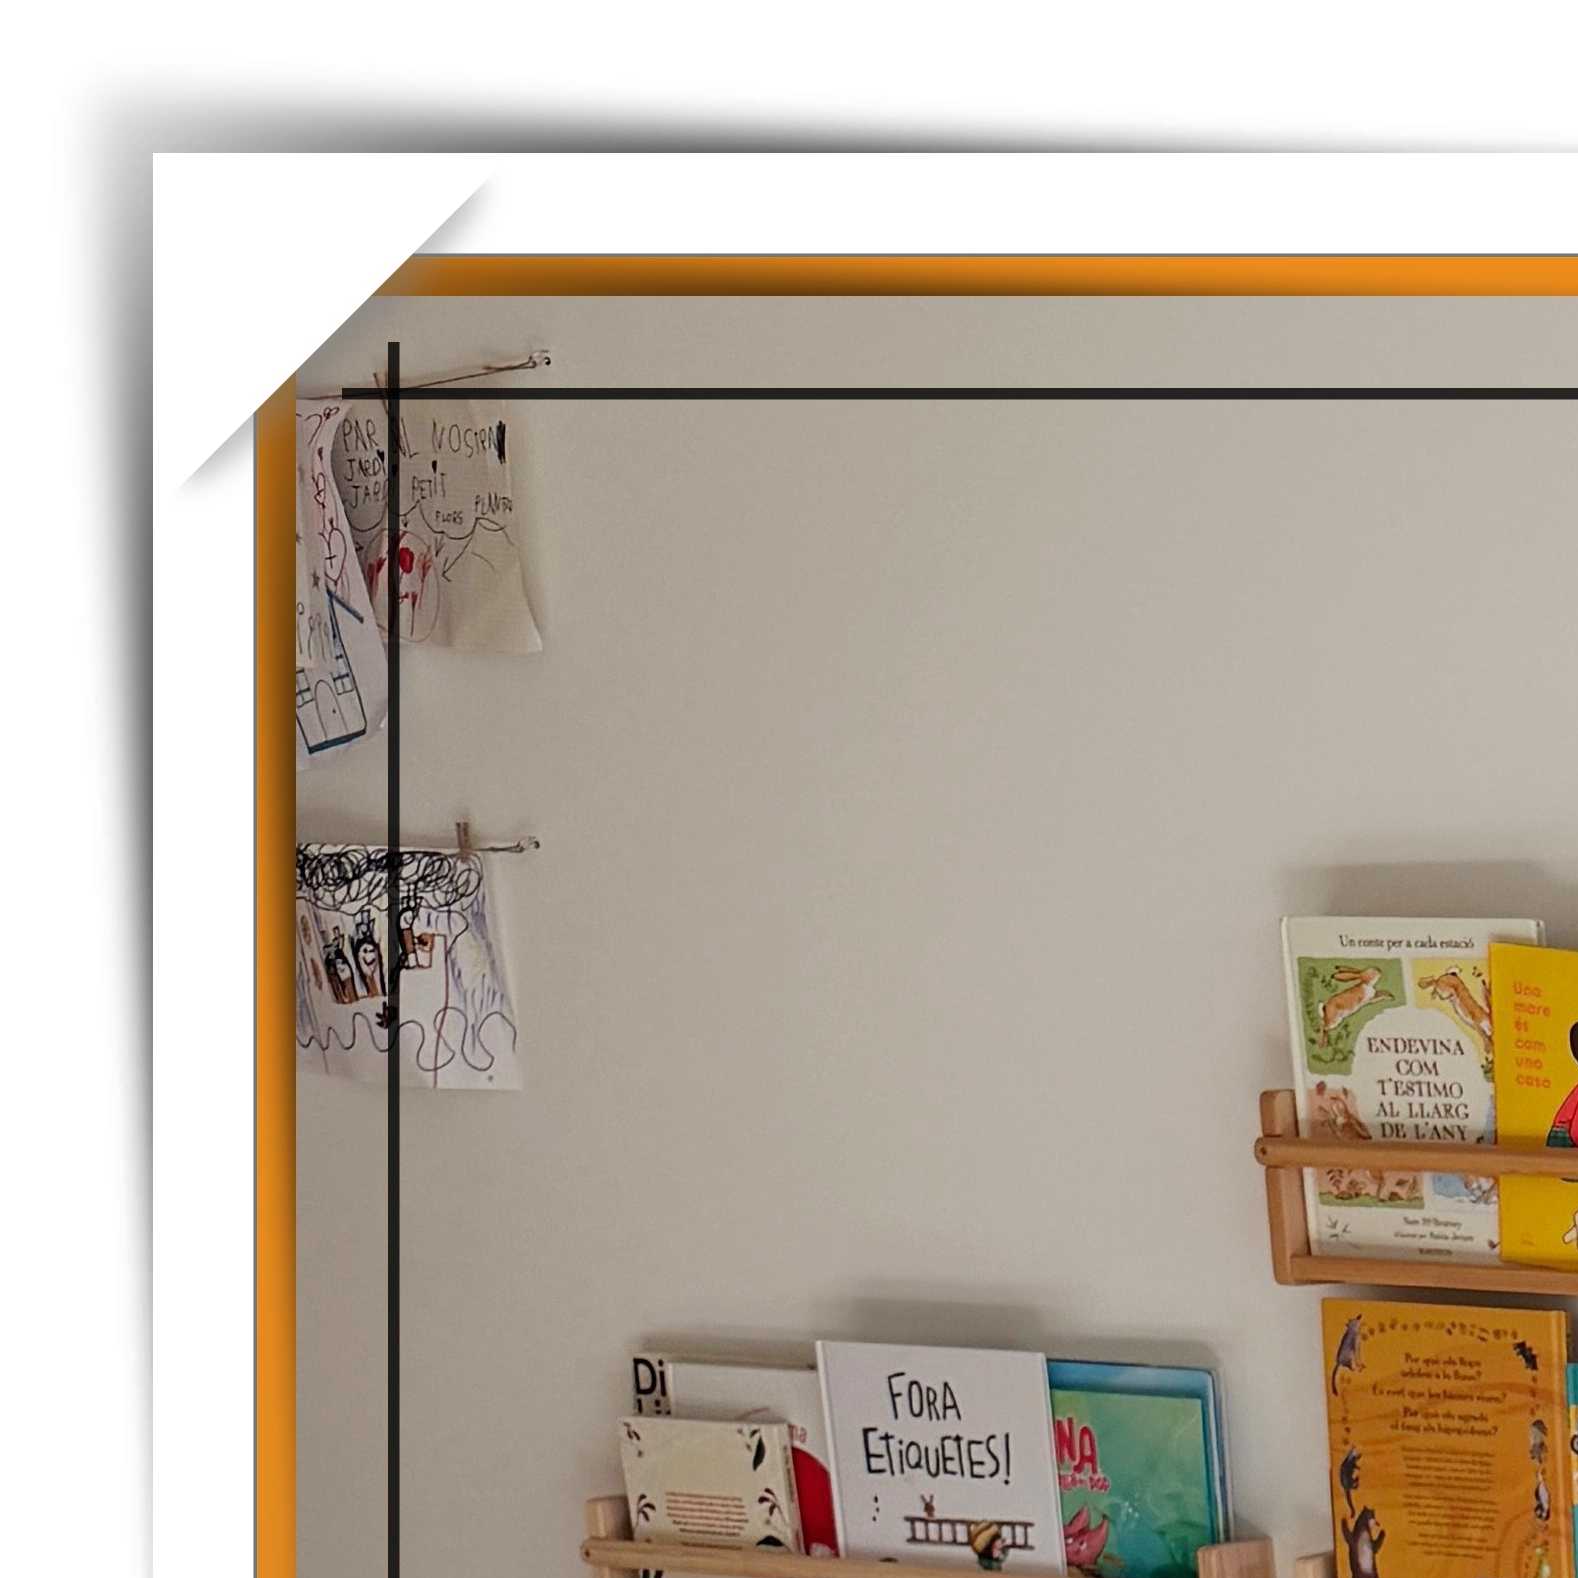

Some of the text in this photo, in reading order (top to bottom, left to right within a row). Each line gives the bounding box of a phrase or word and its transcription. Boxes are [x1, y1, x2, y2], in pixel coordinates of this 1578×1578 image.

[1339, 935, 1355, 949] Un
[1388, 939, 1404, 951] per
[1406, 940, 1412, 949] a
[1414, 936, 1438, 949] cada
[1513, 980, 1542, 998] Una
[1514, 1002, 1551, 1017] mare
[1367, 1037, 1465, 1056] ENDEVINA
[1514, 1038, 1546, 1052] com
[1396, 1059, 1439, 1077] COM
[1515, 1056, 1543, 1069] una
[1377, 1078, 1464, 1099] T'ESTIMO
[1515, 1073, 1551, 1089] casa
[1376, 1102, 1470, 1120] AL LLARG
[1380, 1121, 1468, 1140] DE L'ANY
[888, 1372, 962, 1421] FORA
